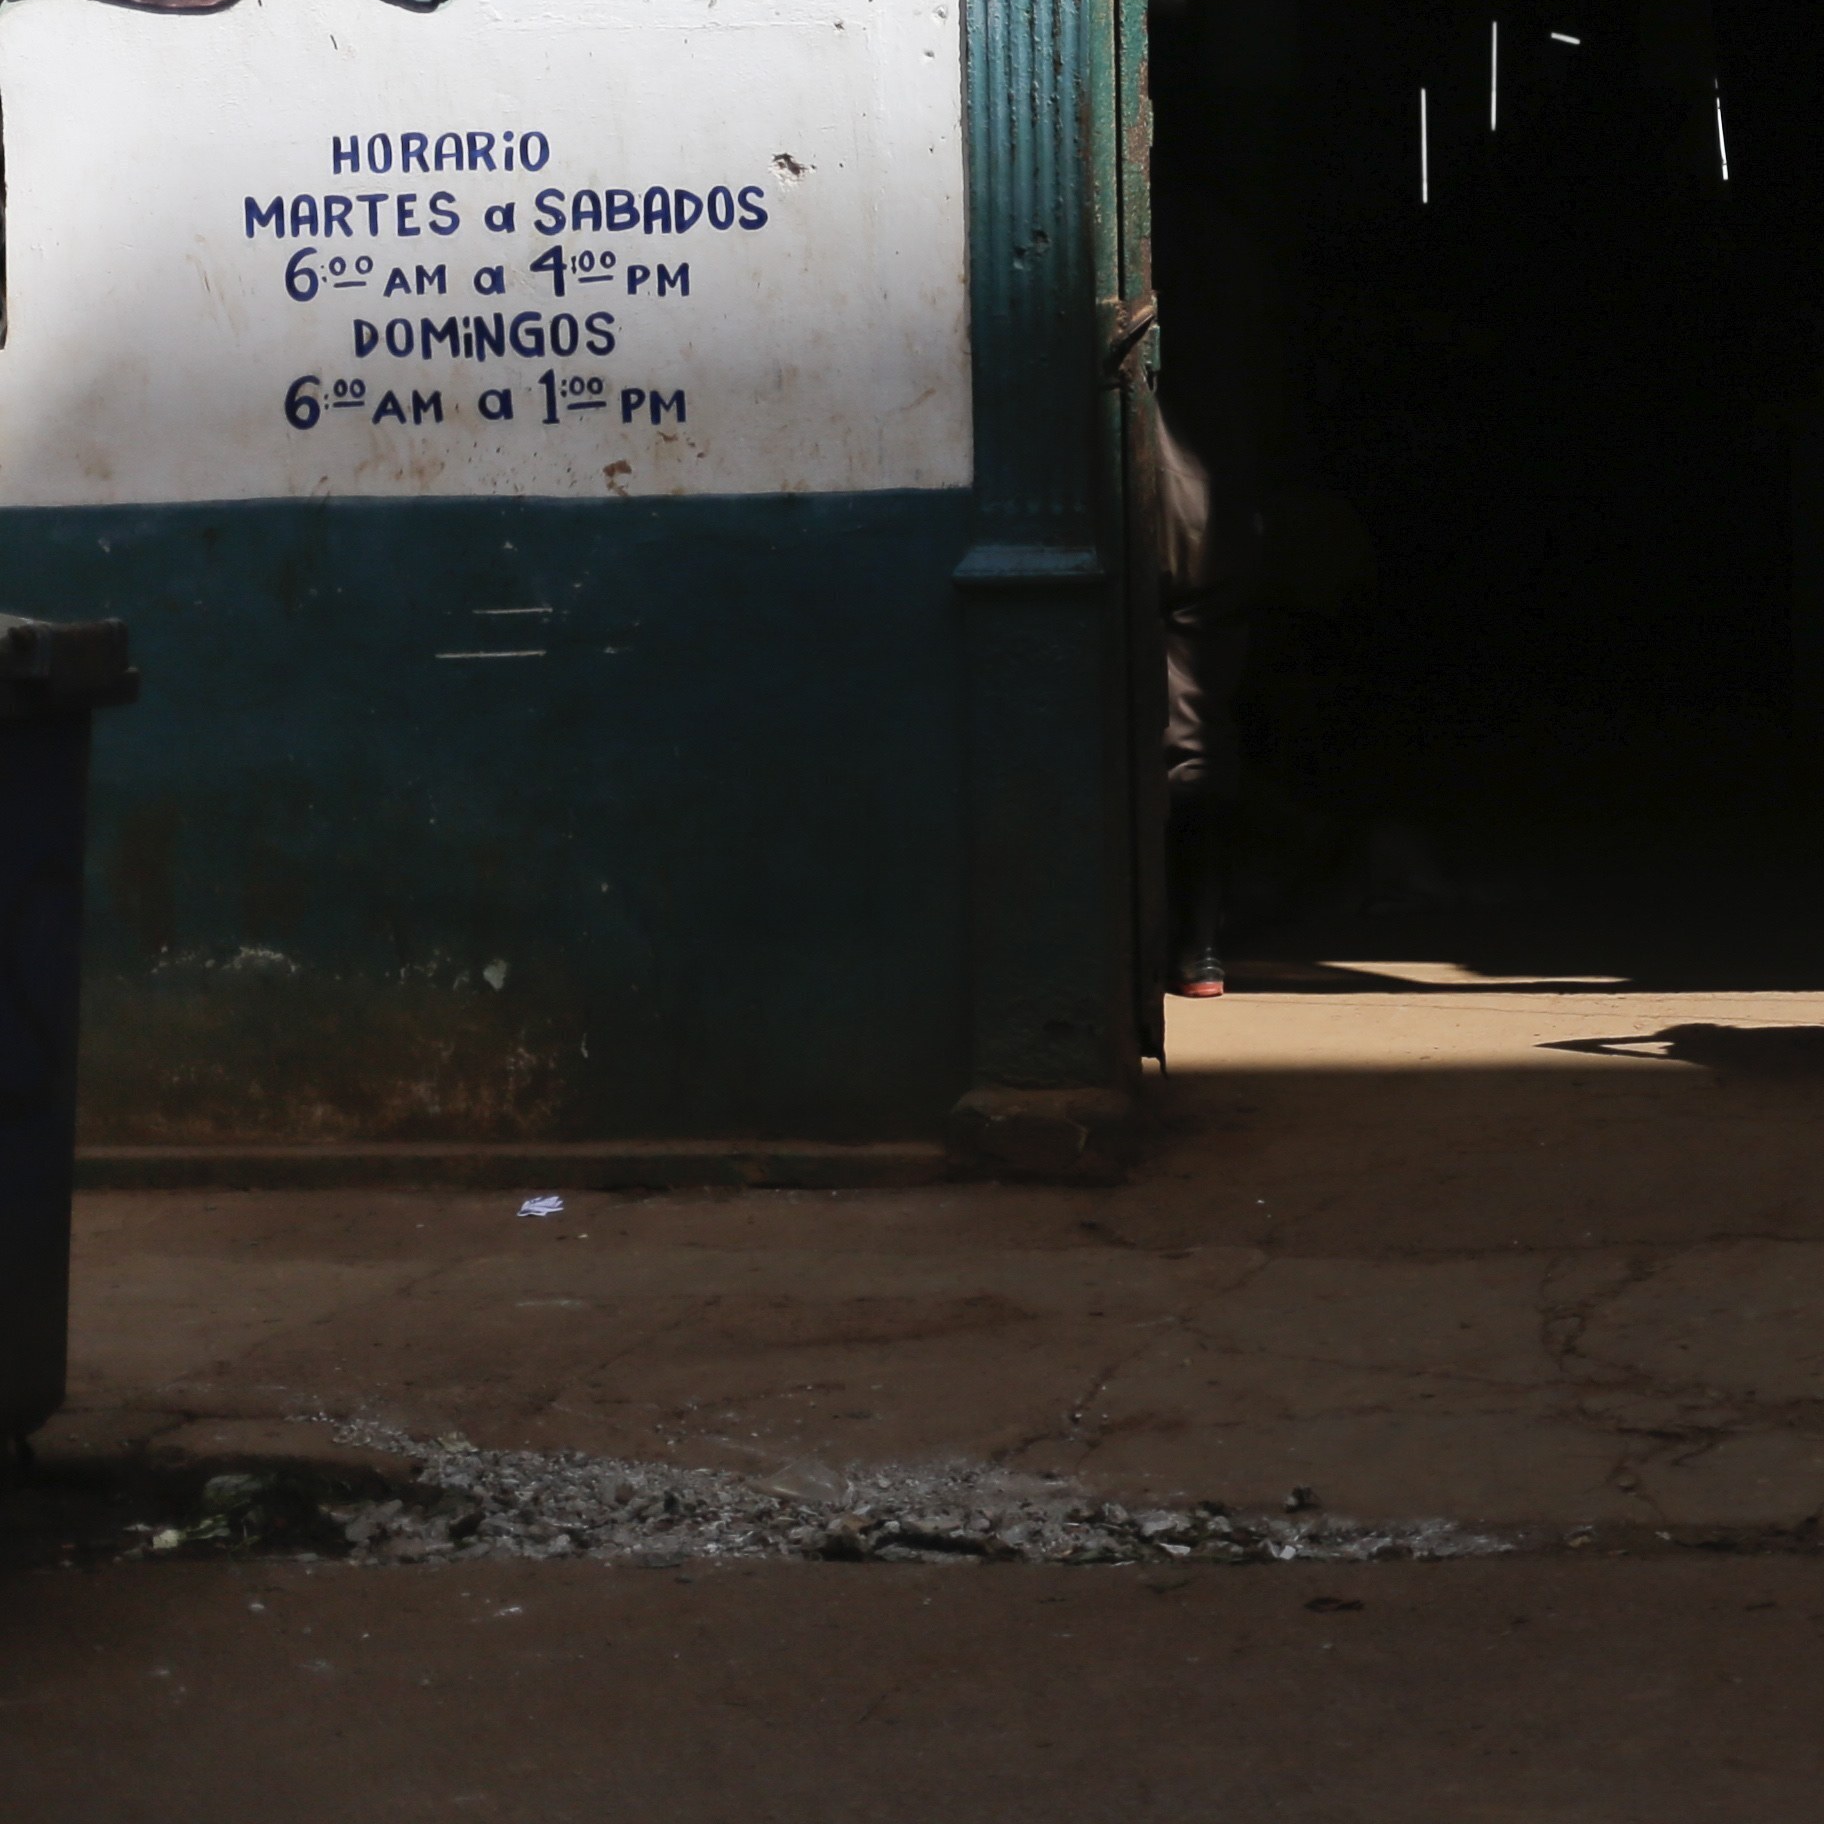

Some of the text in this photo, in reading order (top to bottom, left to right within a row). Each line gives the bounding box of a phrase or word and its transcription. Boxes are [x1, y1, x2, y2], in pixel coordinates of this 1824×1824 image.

[244, 185, 769, 239] MARTES a SABADOS
[383, 263, 447, 298] AM
[473, 265, 506, 296] a
[626, 262, 690, 298] PM
[371, 389, 444, 426] AM
[477, 388, 514, 421] a
[620, 387, 687, 426] PM
